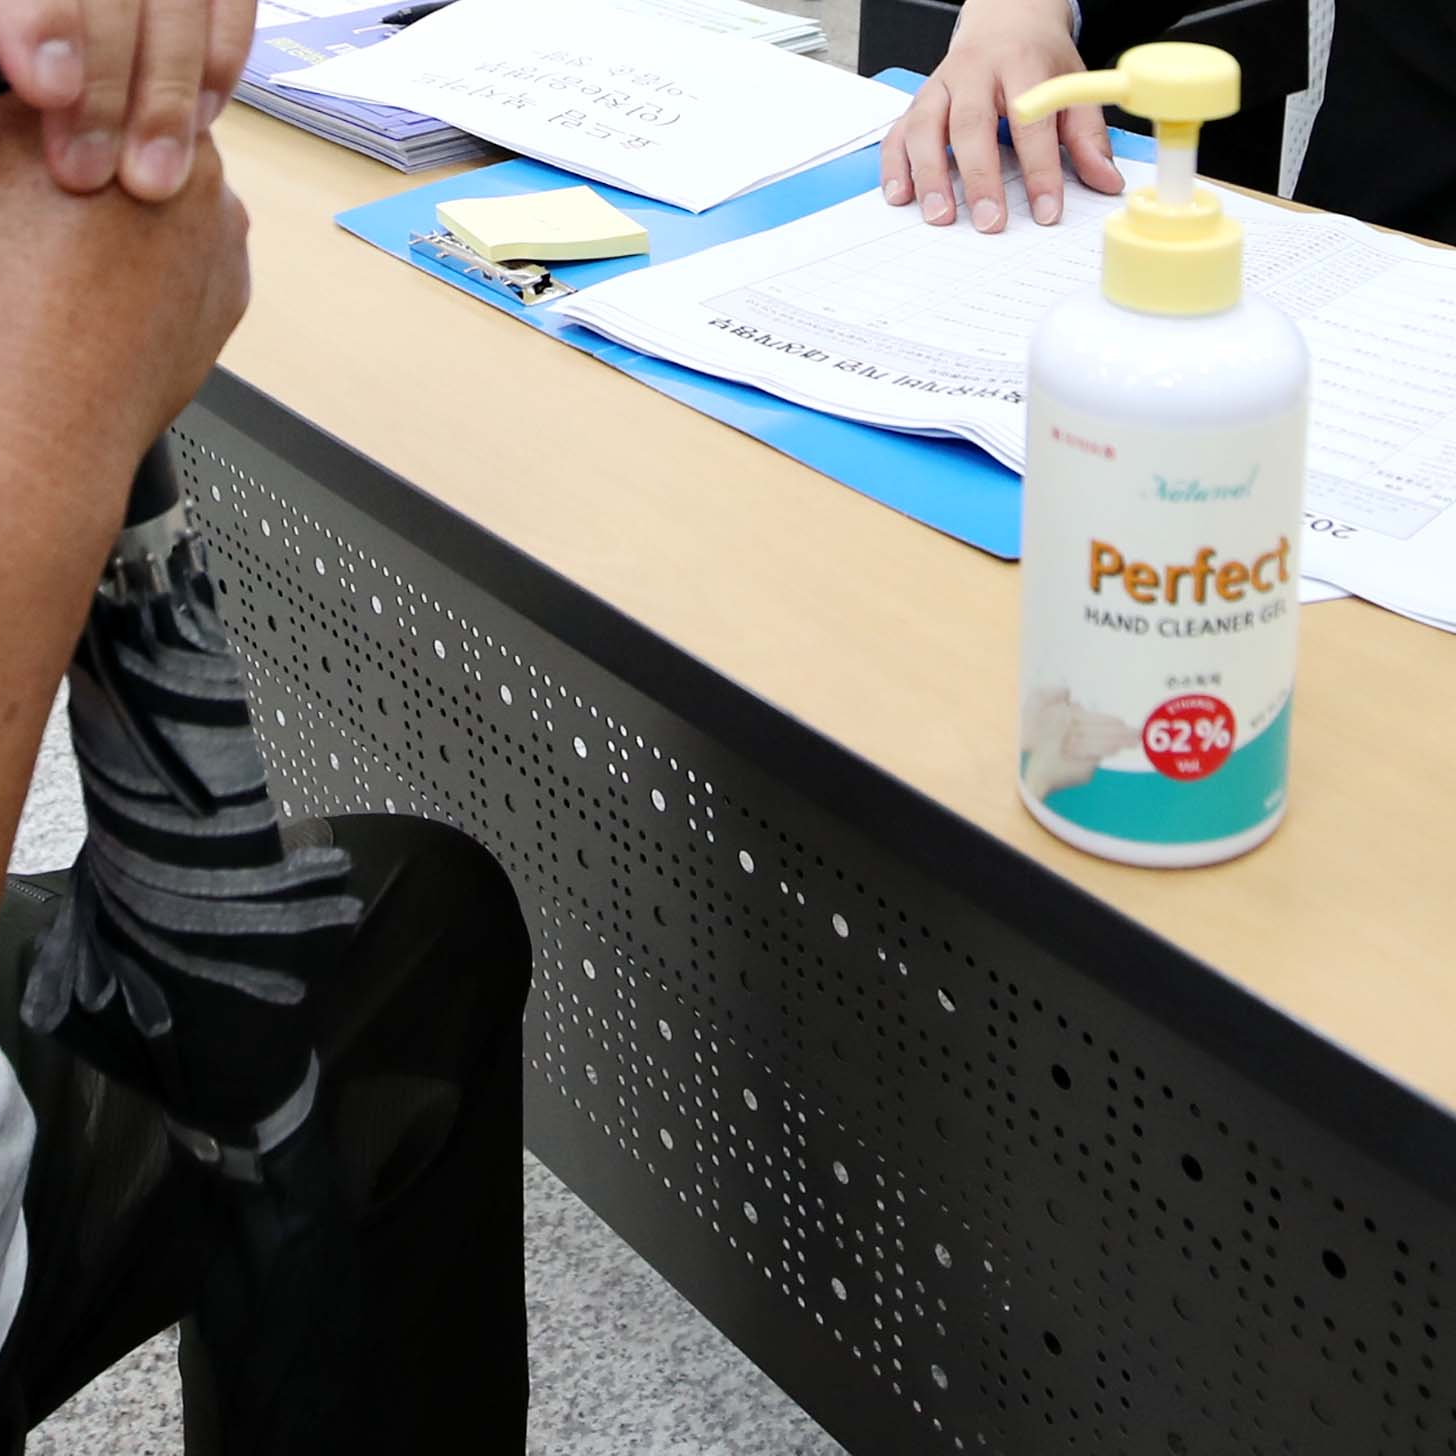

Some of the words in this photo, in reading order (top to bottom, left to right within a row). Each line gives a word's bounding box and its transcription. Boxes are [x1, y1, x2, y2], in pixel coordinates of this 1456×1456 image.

[706, 317, 831, 365] 대상자명부
[833, 359, 890, 382] 지원
[1088, 534, 1291, 606] Perfect
[1085, 606, 1149, 636] HAND
[1157, 610, 1255, 639] CLEANER
[1146, 714, 1231, 754] 62%
